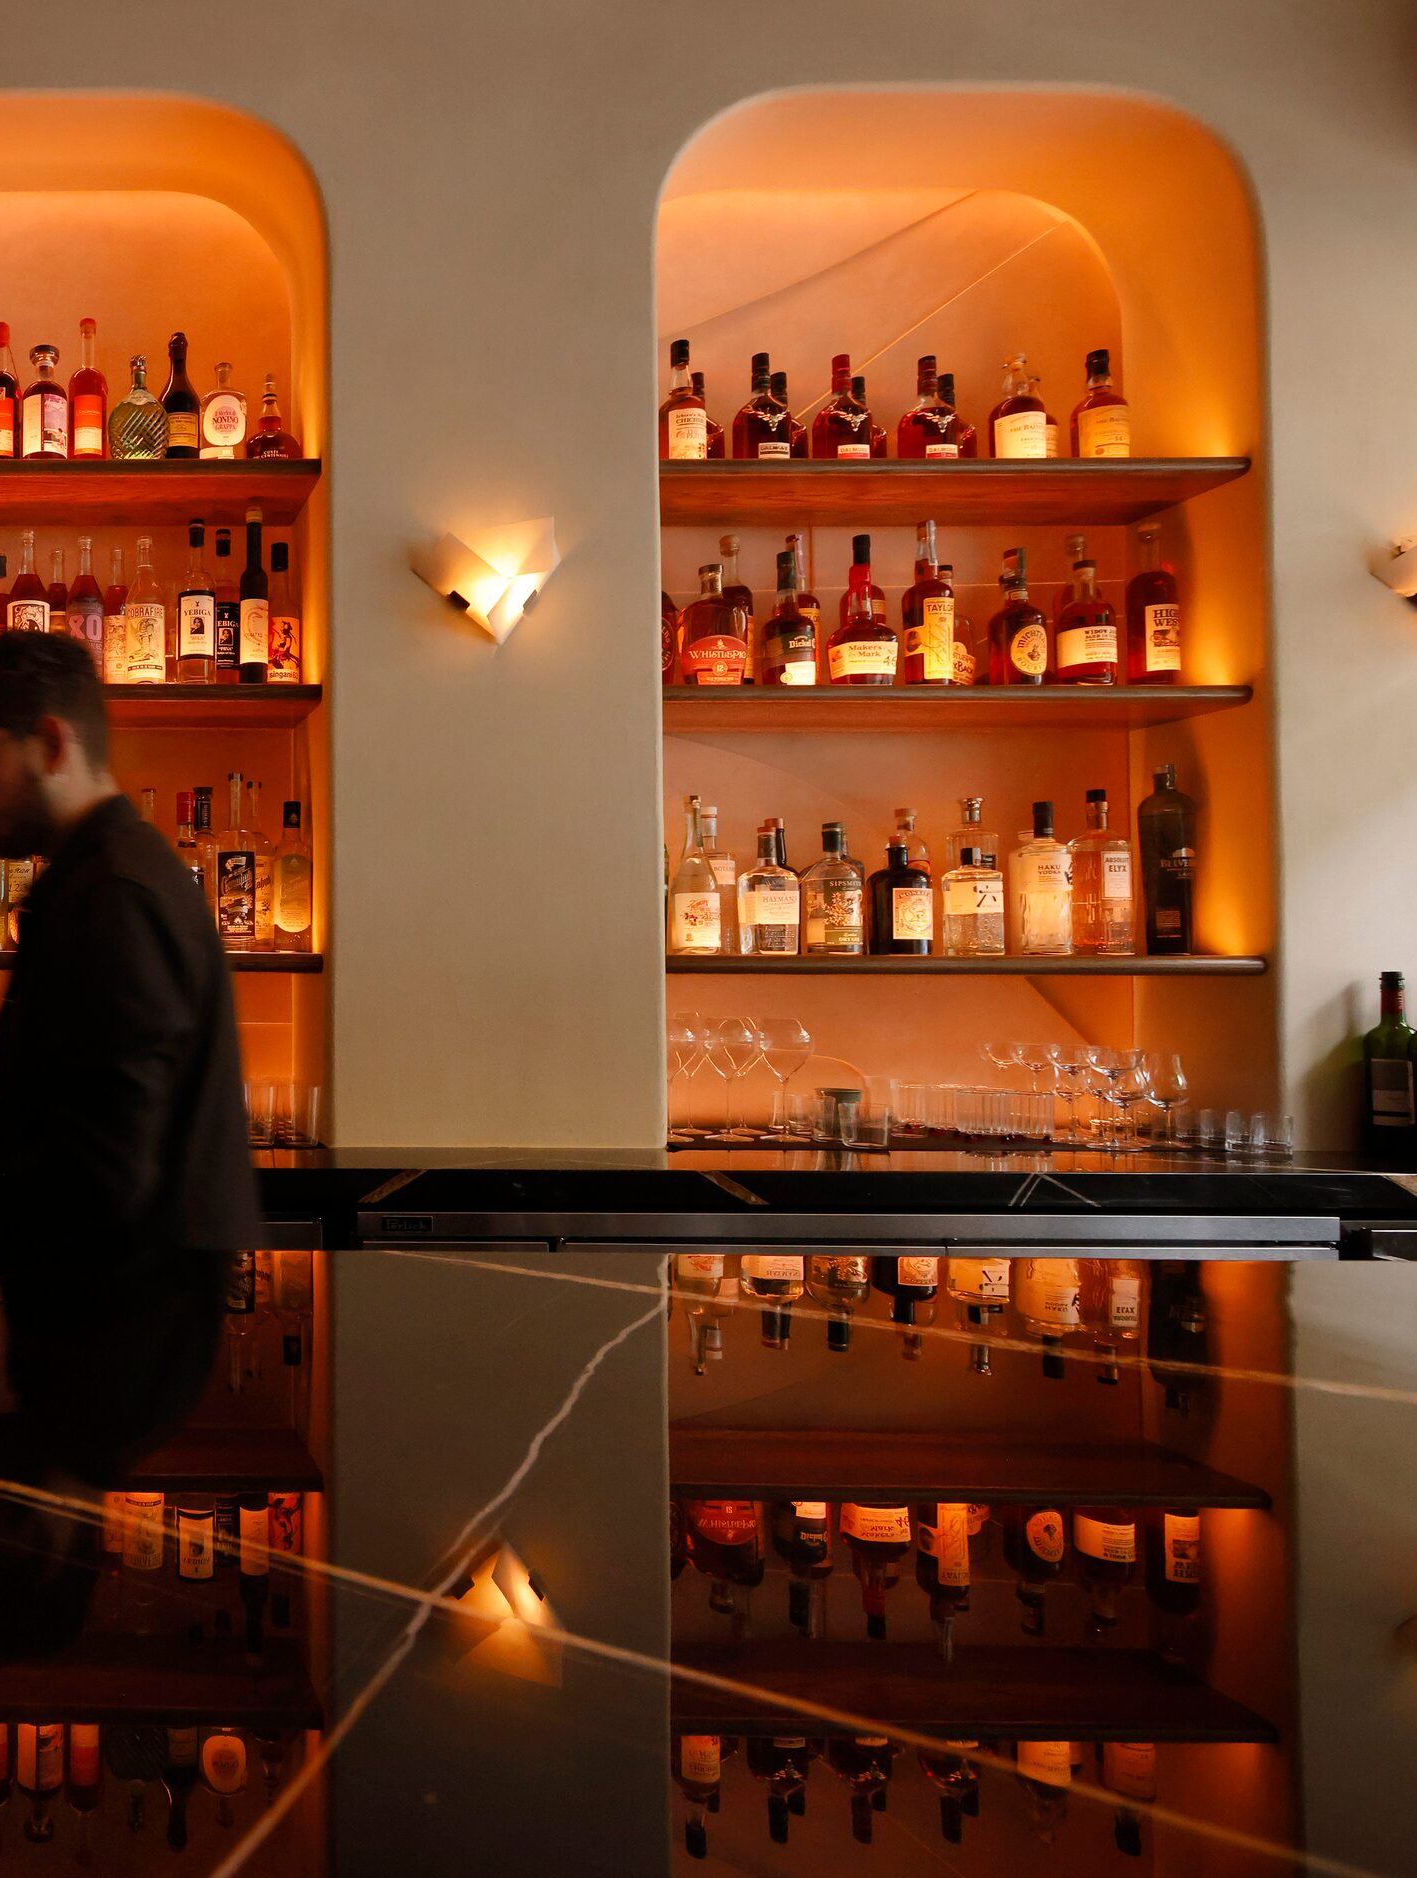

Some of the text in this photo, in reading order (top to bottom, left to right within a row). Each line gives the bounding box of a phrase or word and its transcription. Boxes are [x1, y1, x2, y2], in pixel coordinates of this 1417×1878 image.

[212, 416, 239, 424] NONINO
[183, 608, 212, 617] YEBIGA
[1153, 608, 1179, 618] HIG
[217, 620, 239, 628] EBIGA
[1153, 618, 1179, 627] WES
[68, 614, 102, 641] XO
[1108, 865, 1127, 873] ELYX
